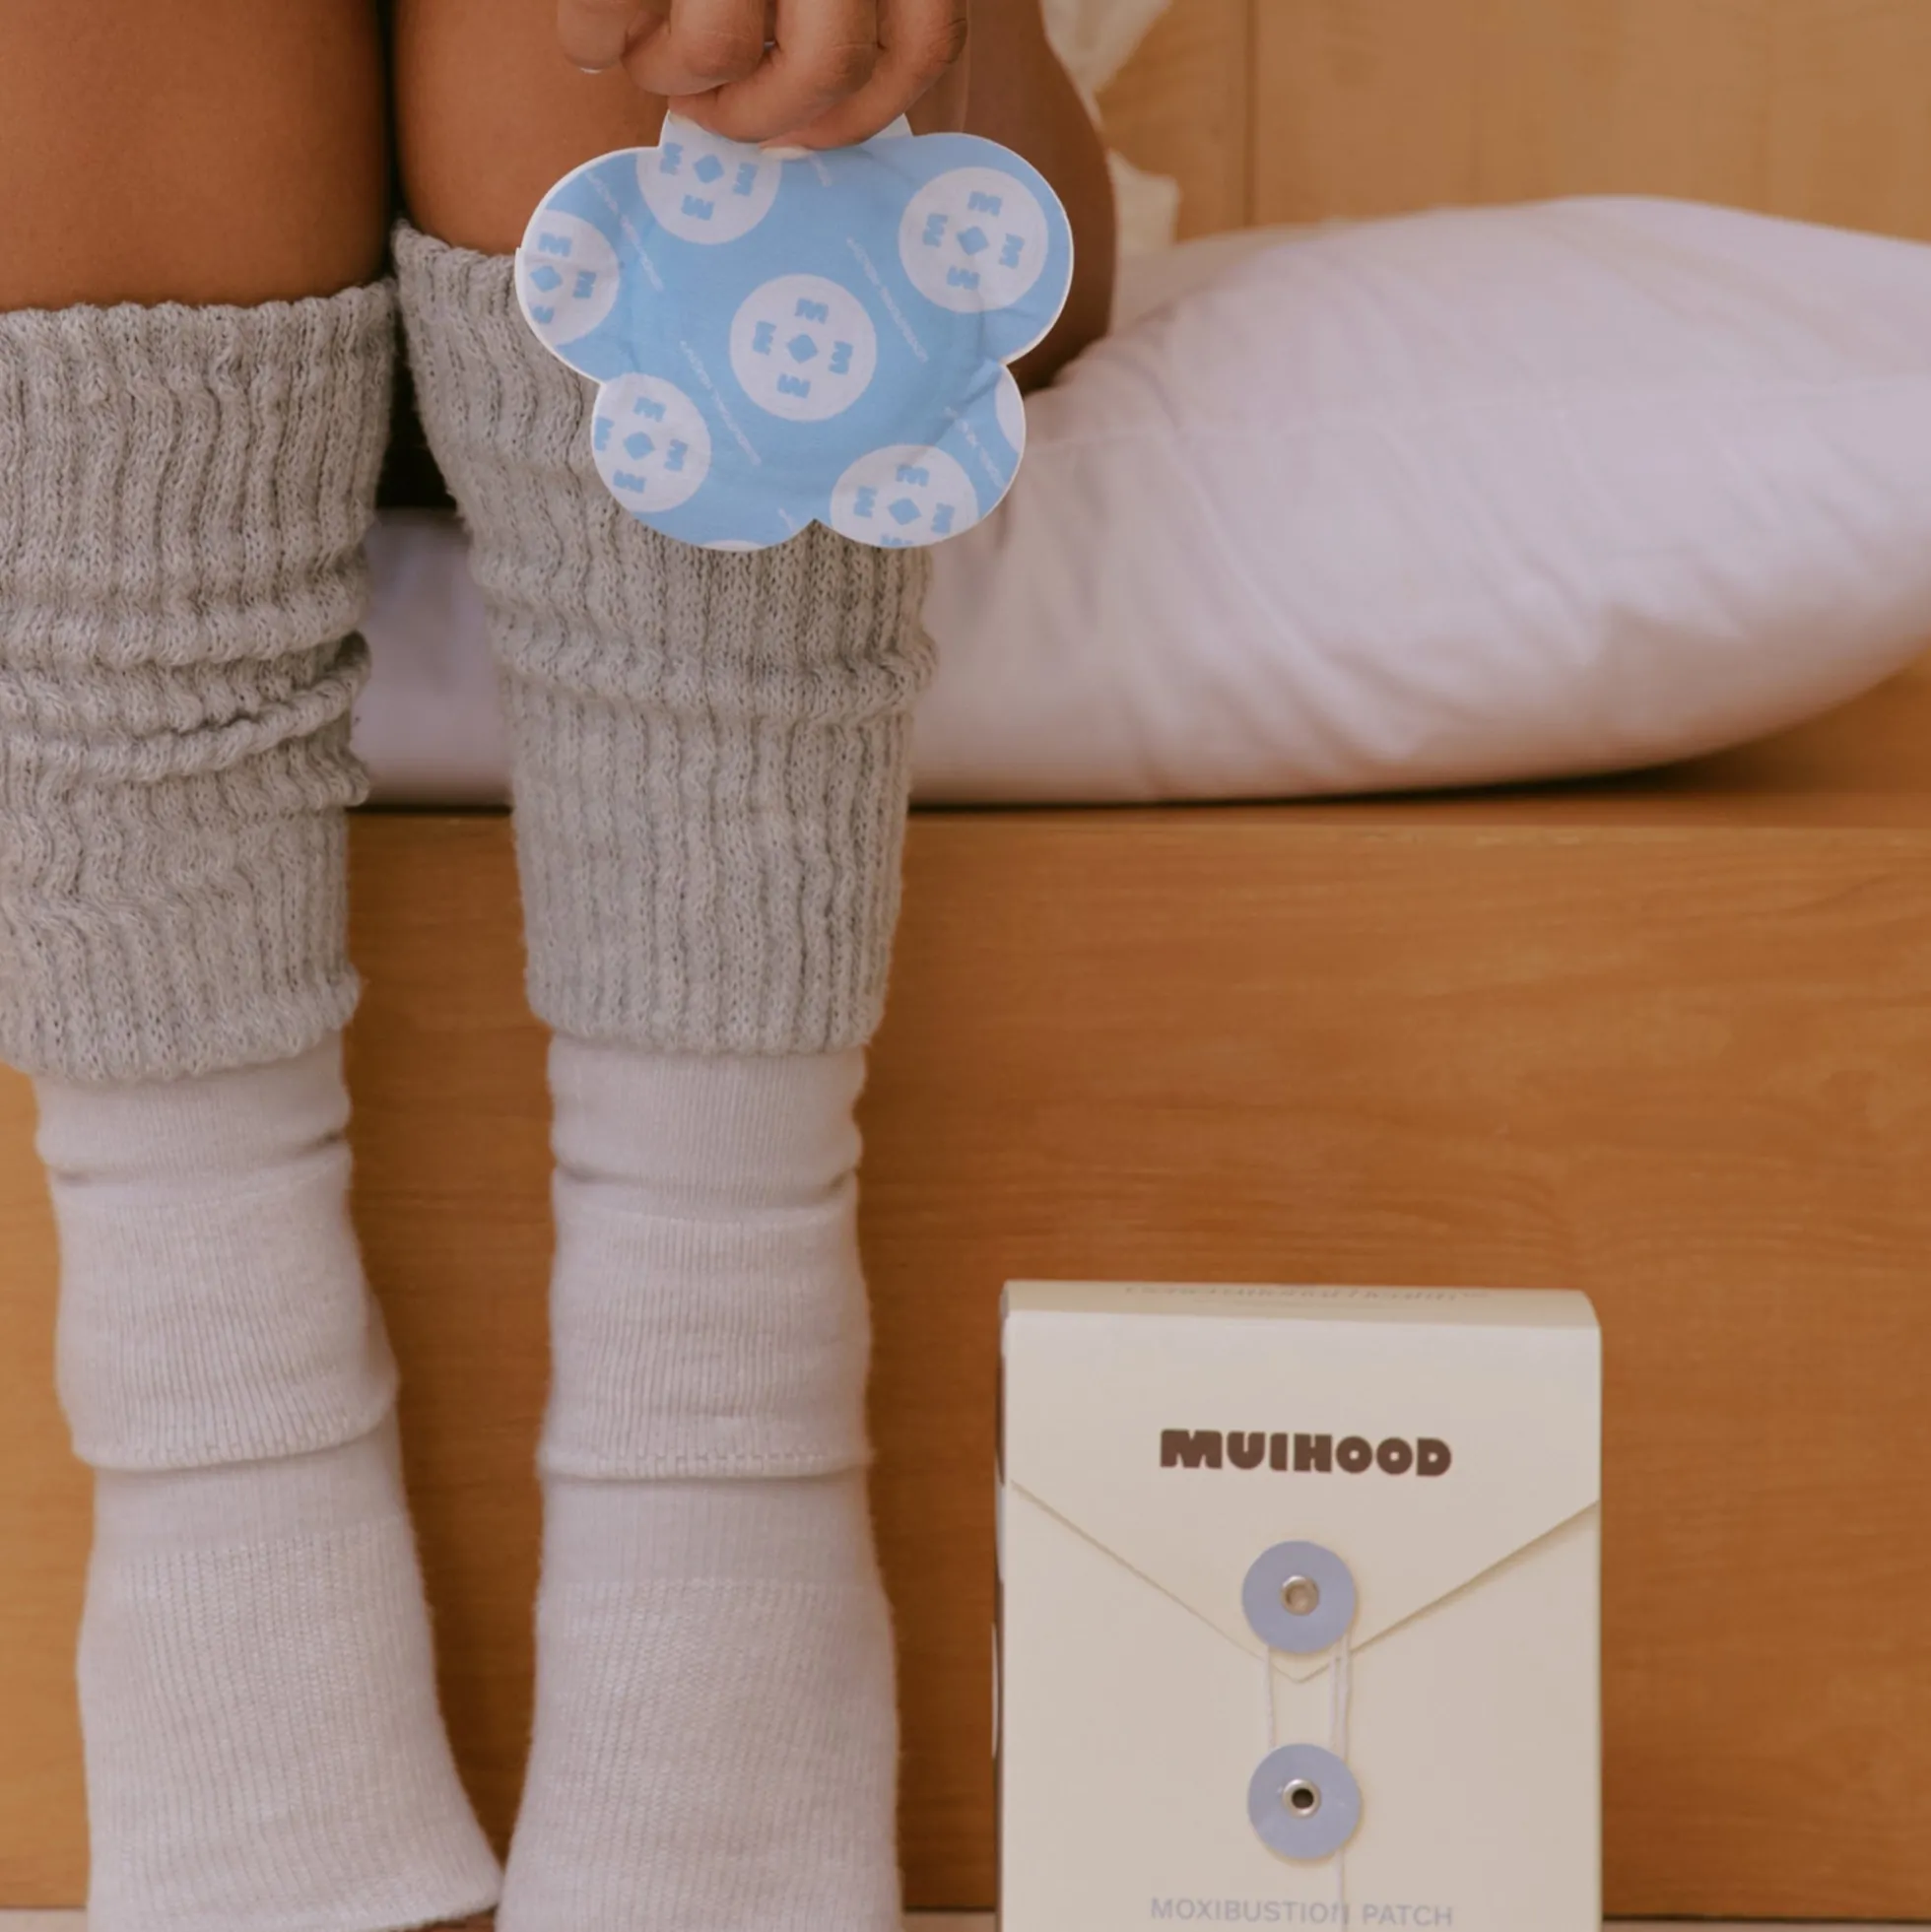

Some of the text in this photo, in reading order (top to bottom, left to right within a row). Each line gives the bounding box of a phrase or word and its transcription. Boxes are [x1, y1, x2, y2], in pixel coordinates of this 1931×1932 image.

[1161, 1429, 1452, 1477] MUIHOOD
[1150, 1897, 1453, 1927] MOXIBUSTION PATCH
